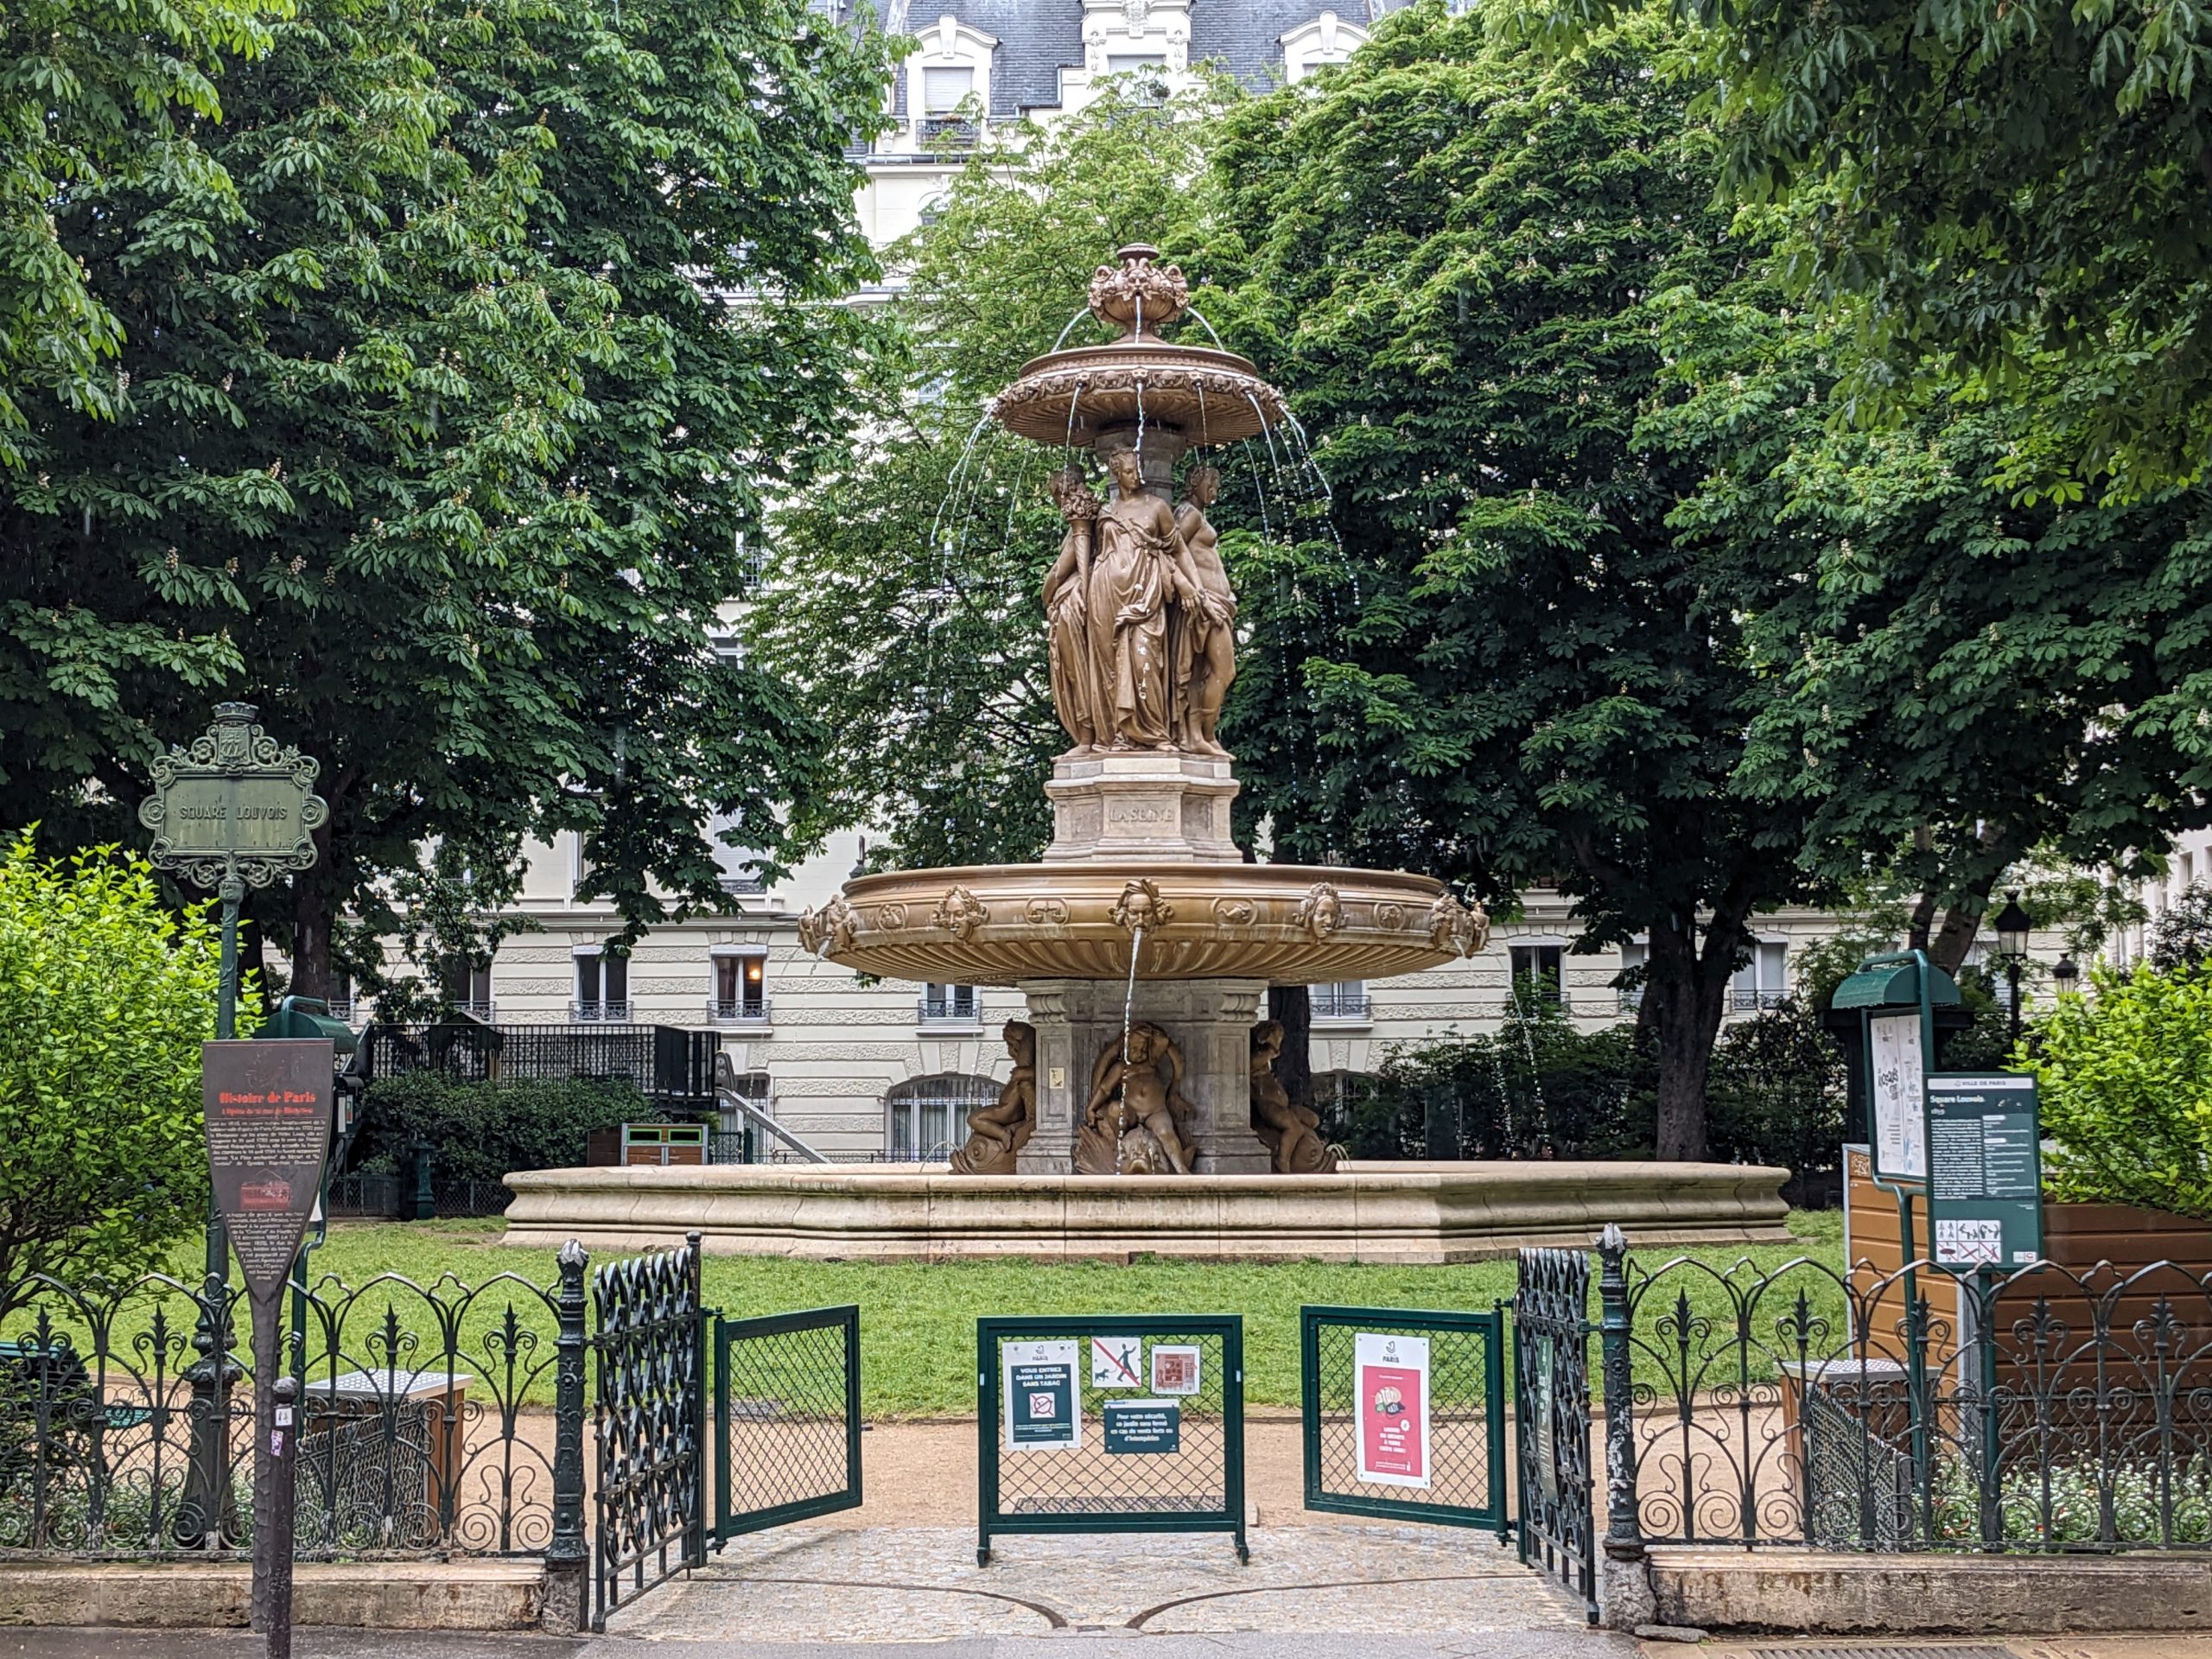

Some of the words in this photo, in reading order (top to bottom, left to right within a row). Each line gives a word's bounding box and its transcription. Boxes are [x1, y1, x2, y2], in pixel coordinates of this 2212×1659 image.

[180, 805, 227, 820] SQUARE
[236, 805, 288, 820] LOUVOIS
[1130, 809, 1174, 823] SEINE
[219, 1091, 264, 1103] Histoire
[268, 1091, 282, 1103] de
[283, 1091, 316, 1103] Paris
[1929, 1095, 1955, 1103] Square
